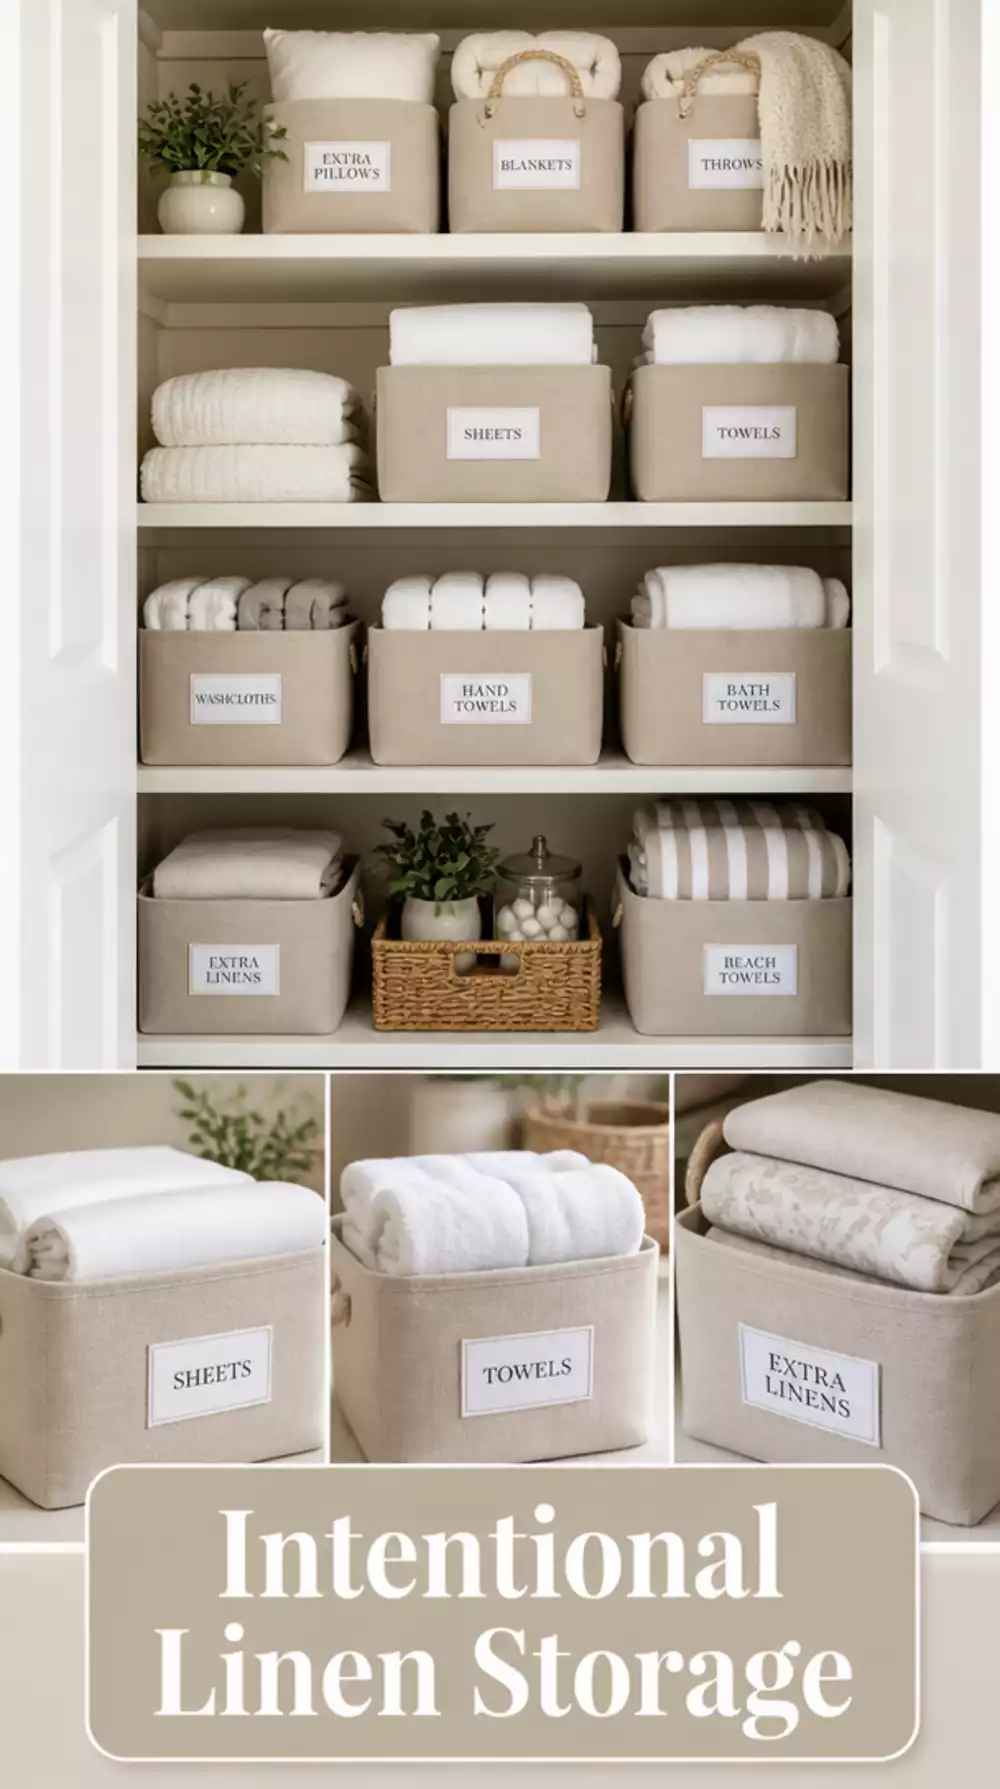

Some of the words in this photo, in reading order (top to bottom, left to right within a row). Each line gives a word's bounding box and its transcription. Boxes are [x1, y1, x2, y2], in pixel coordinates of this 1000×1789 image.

[322, 152, 371, 165] EXTRA
[500, 159, 572, 171] BLANKETS
[313, 167, 380, 180] PILLOWS
[463, 428, 522, 441] SHEETS
[717, 426, 782, 440] TOWELS
[462, 684, 510, 698] HAND
[726, 683, 771, 697] BATH
[195, 692, 277, 705] WASHCLOTHS
[717, 699, 781, 712] TOWELS
[454, 700, 517, 713] TOWELS
[208, 956, 260, 970] EXTRA
[723, 956, 777, 970] BEACH
[205, 970, 262, 984] LINENS
[719, 971, 782, 984] TOWELS
[173, 1359, 252, 1390] SHEETS
[482, 1357, 572, 1385] TOWELS
[768, 1352, 847, 1393] EXTRA
[765, 1374, 851, 1418] LINENS
